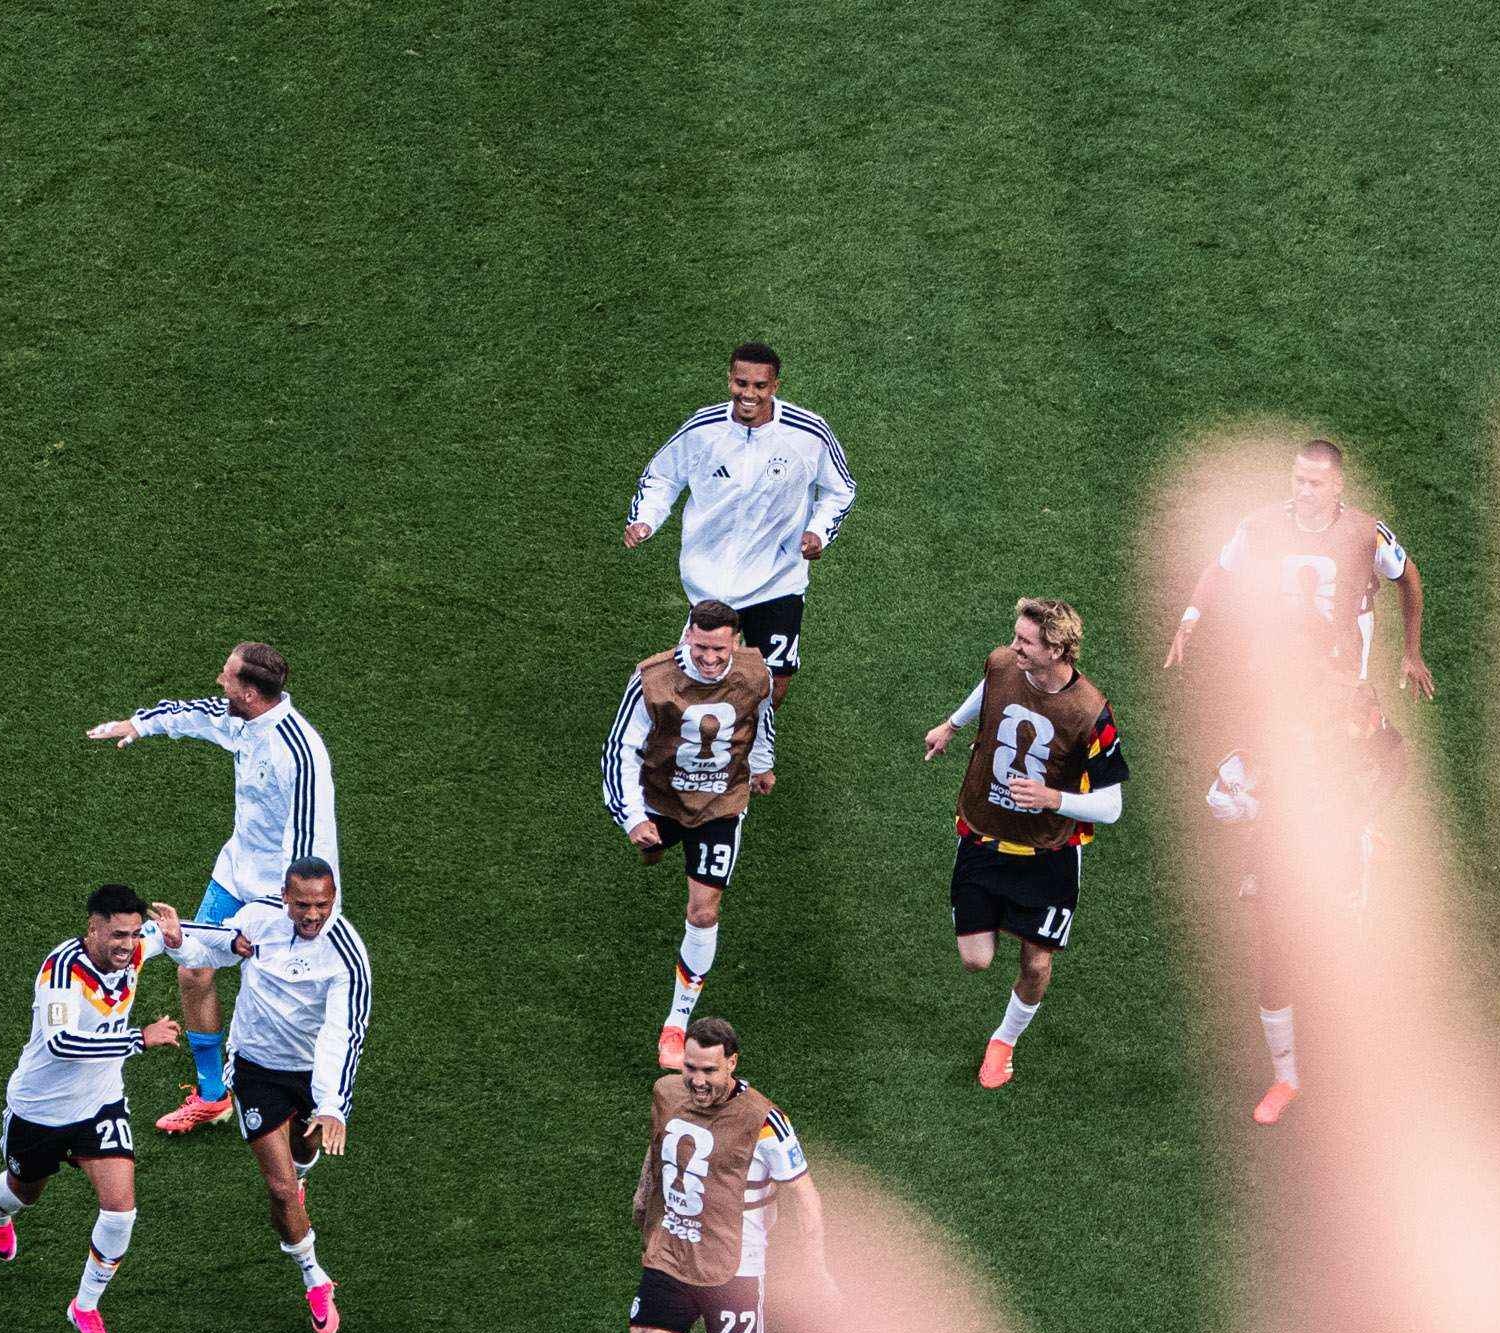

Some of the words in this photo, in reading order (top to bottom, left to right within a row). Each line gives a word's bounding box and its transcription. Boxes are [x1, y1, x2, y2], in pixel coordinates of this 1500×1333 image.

[765, 633, 801, 668] 24
[671, 776, 728, 794] 2026
[708, 771, 729, 781] CUP
[988, 791, 1043, 814] 20
[696, 842, 732, 878] 13
[95, 1118, 135, 1152] 20
[668, 1191, 688, 1208] FIFA
